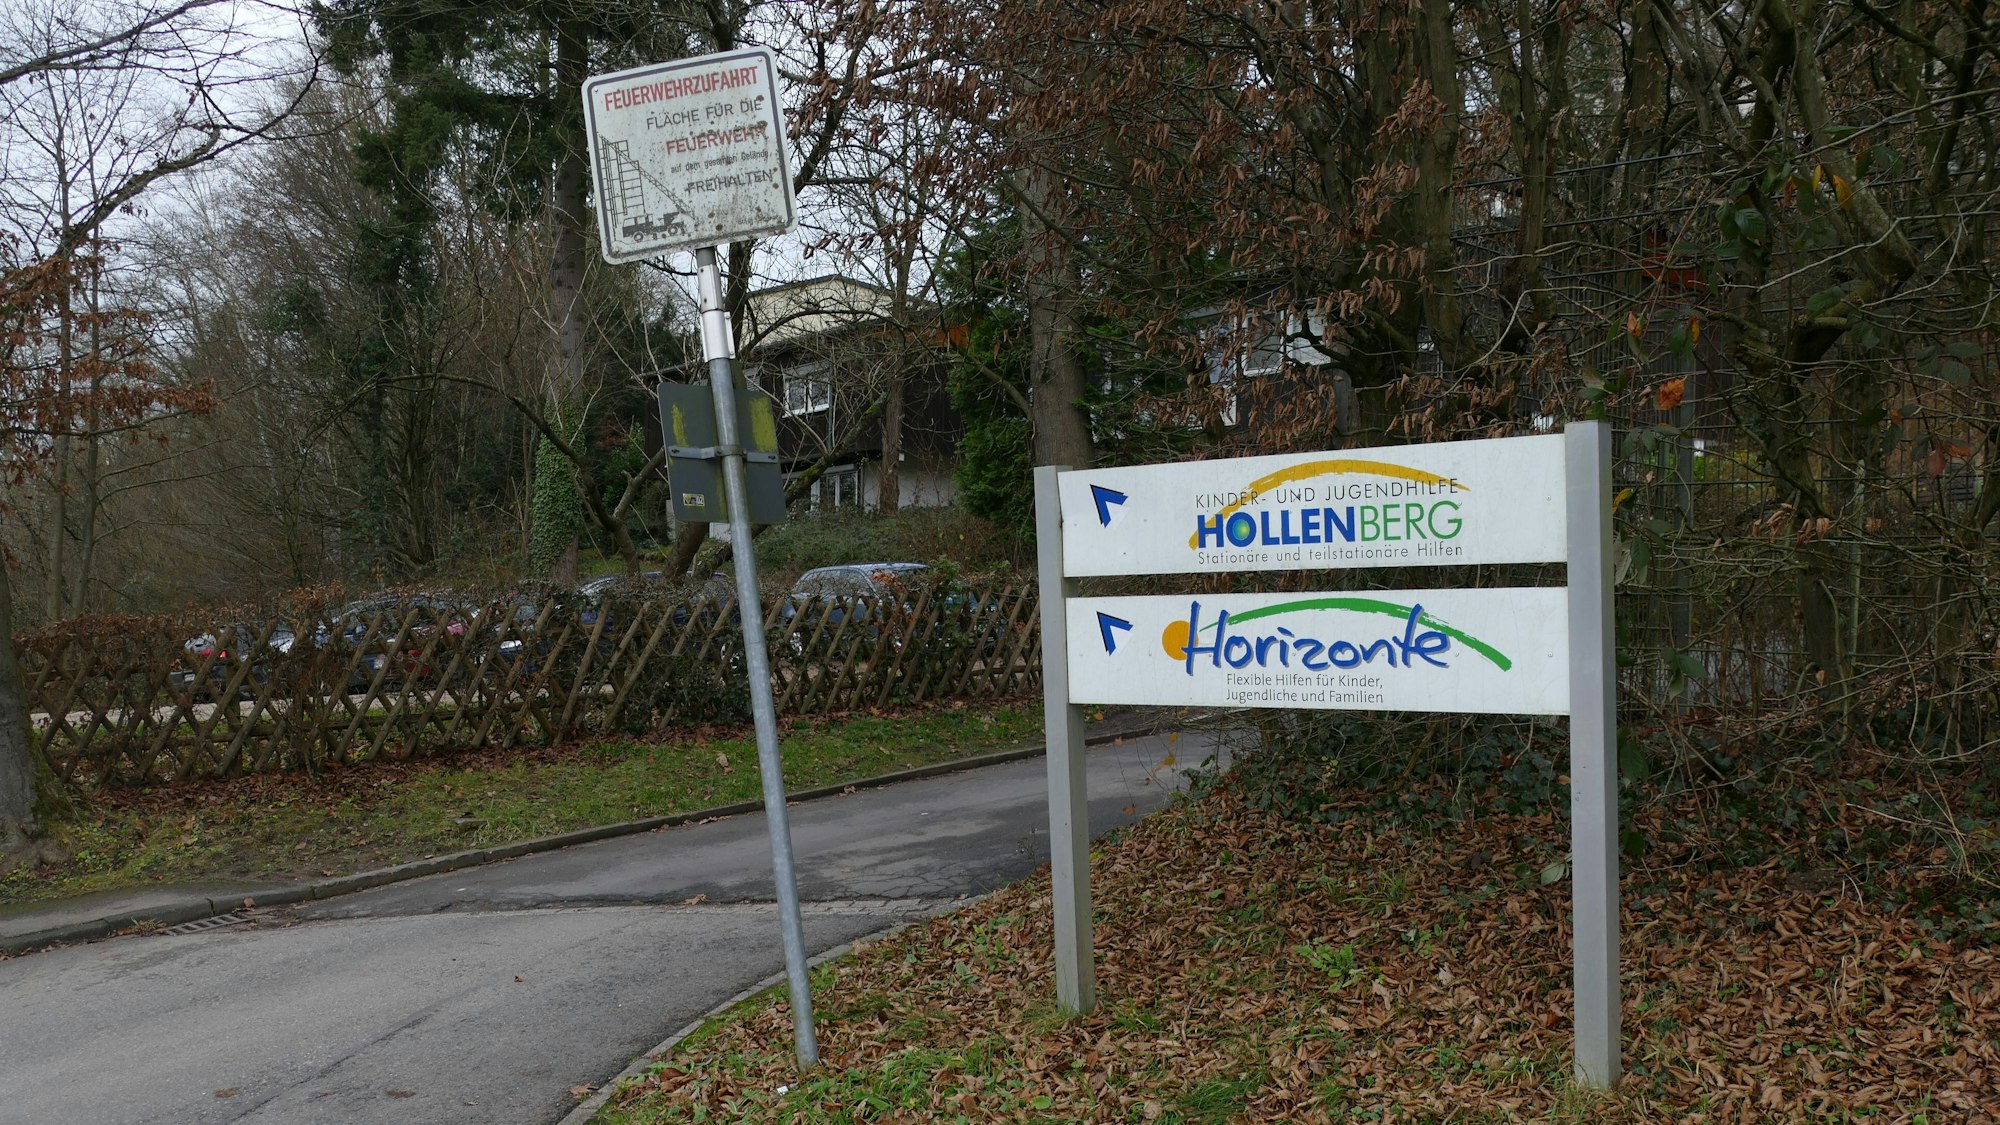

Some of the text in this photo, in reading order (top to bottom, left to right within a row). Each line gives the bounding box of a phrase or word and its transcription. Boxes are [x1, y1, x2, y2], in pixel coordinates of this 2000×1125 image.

[604, 66, 758, 111] FEUERWEHRZUFAHRT
[646, 99, 763, 130] FLÄCHE FÜR DIE
[666, 125, 768, 155] FEUERWEHR
[671, 163, 682, 174] auf
[685, 161, 700, 172] dem
[741, 149, 769, 161] Gelände
[685, 168, 774, 195] FREIHALTEN
[1195, 478, 1459, 509] KINDER- UND JUGENDHILFE
[1197, 500, 1463, 549] HOLLENBERG
[1198, 540, 1463, 565] Stationäre und teilstationäre Hilfen
[1181, 600, 1451, 676] Horizonte
[1226, 673, 1383, 689] Flexible Hilfen für Kinder,
[1226, 689, 1384, 704] Jugendliche und Familien
